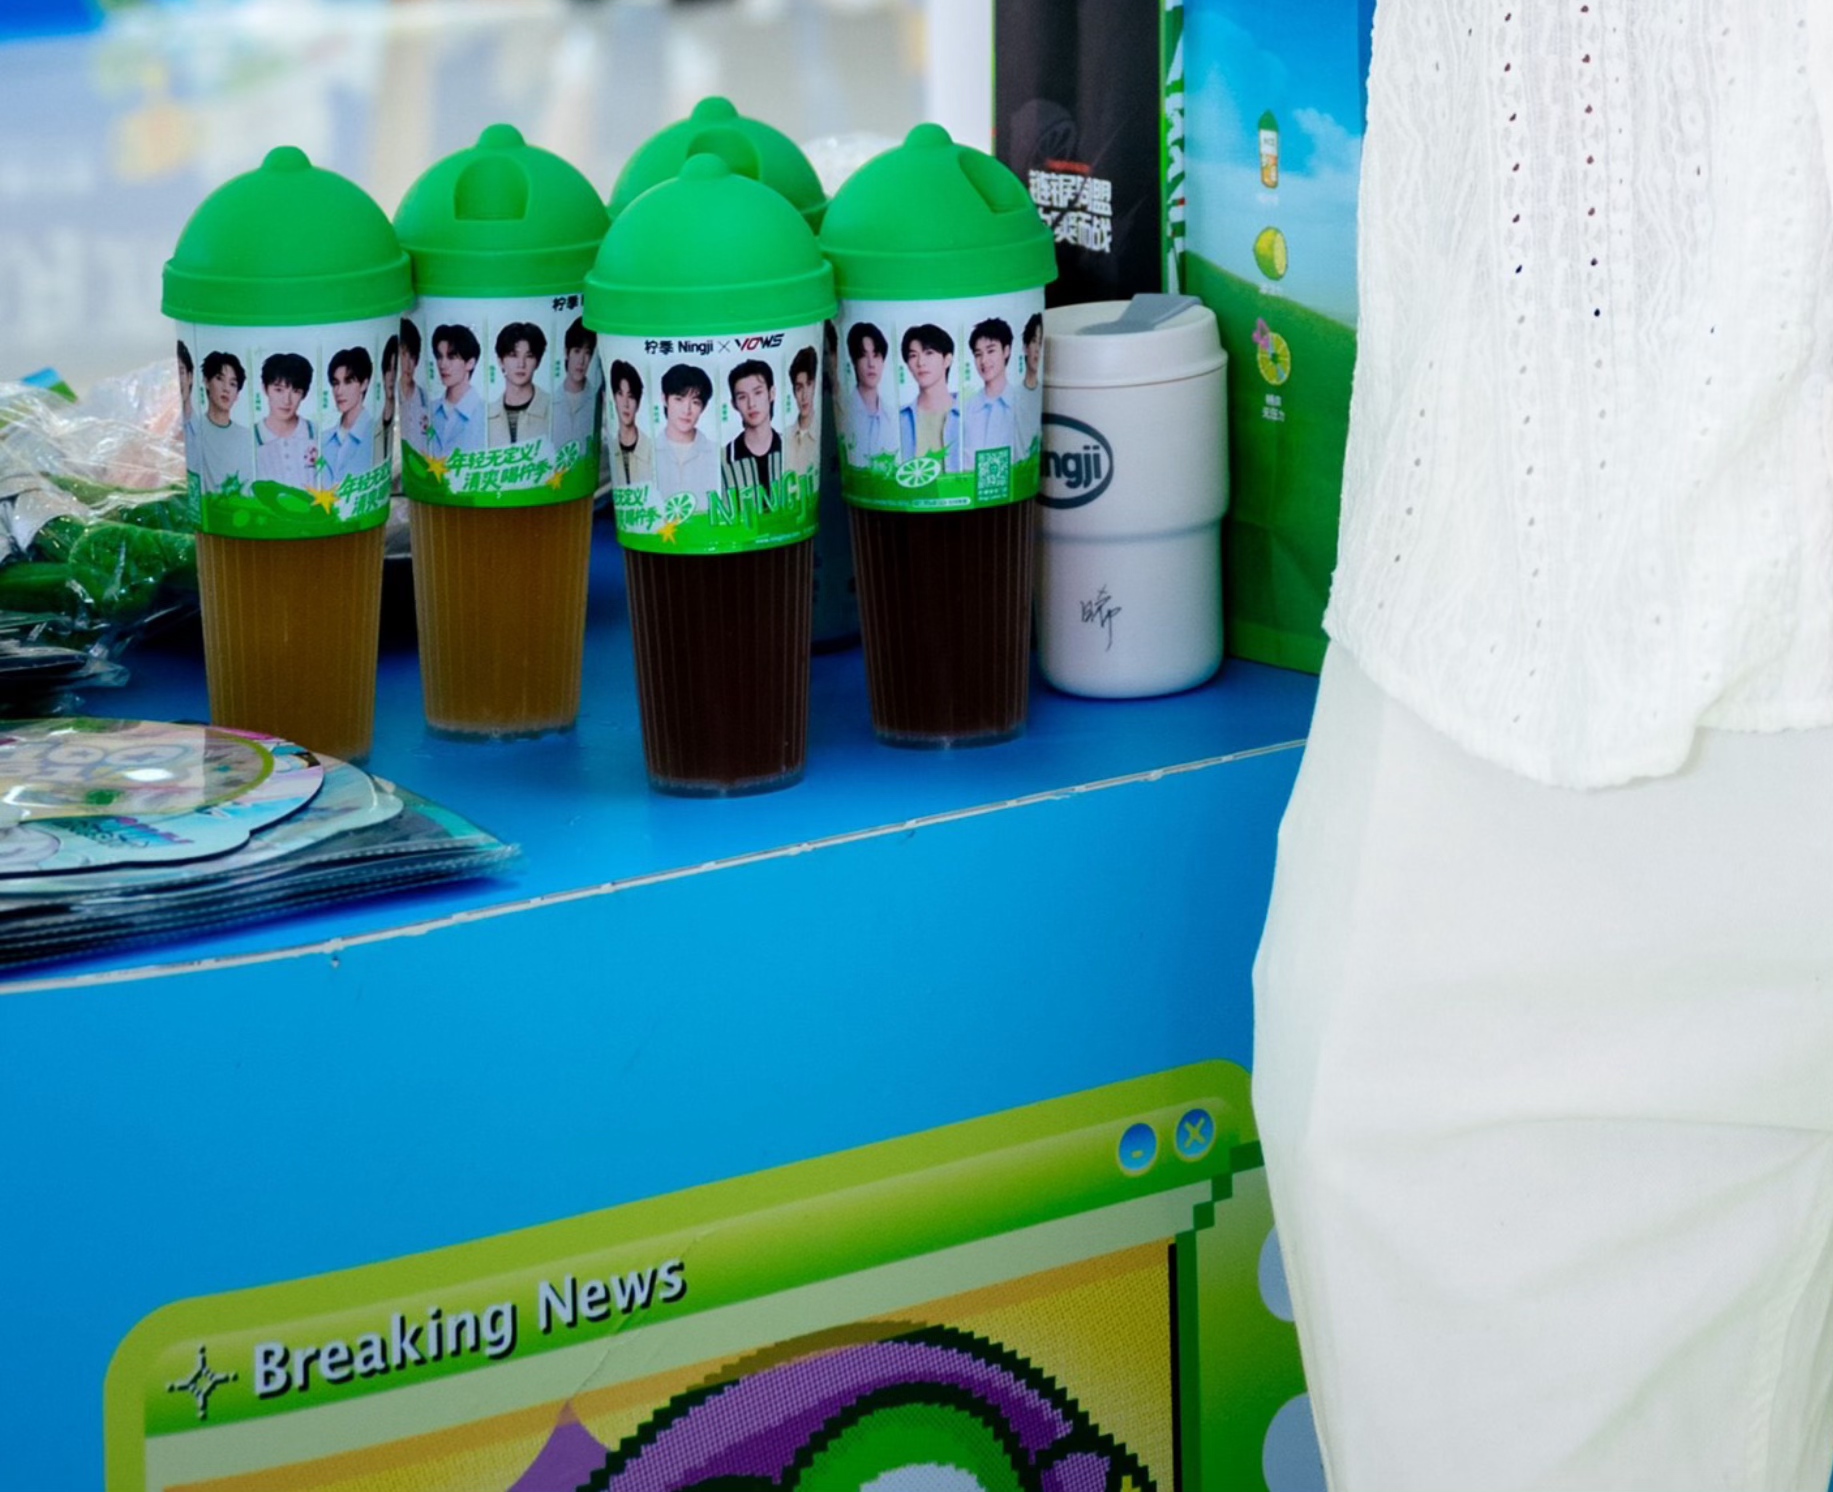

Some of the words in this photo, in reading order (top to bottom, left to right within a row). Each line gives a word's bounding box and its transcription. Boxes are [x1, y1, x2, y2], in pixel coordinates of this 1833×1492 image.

[644, 338, 675, 356] 柠季
[678, 339, 714, 356] Ningji
[251, 1301, 518, 1398] Breaking
[535, 1256, 688, 1331] News
